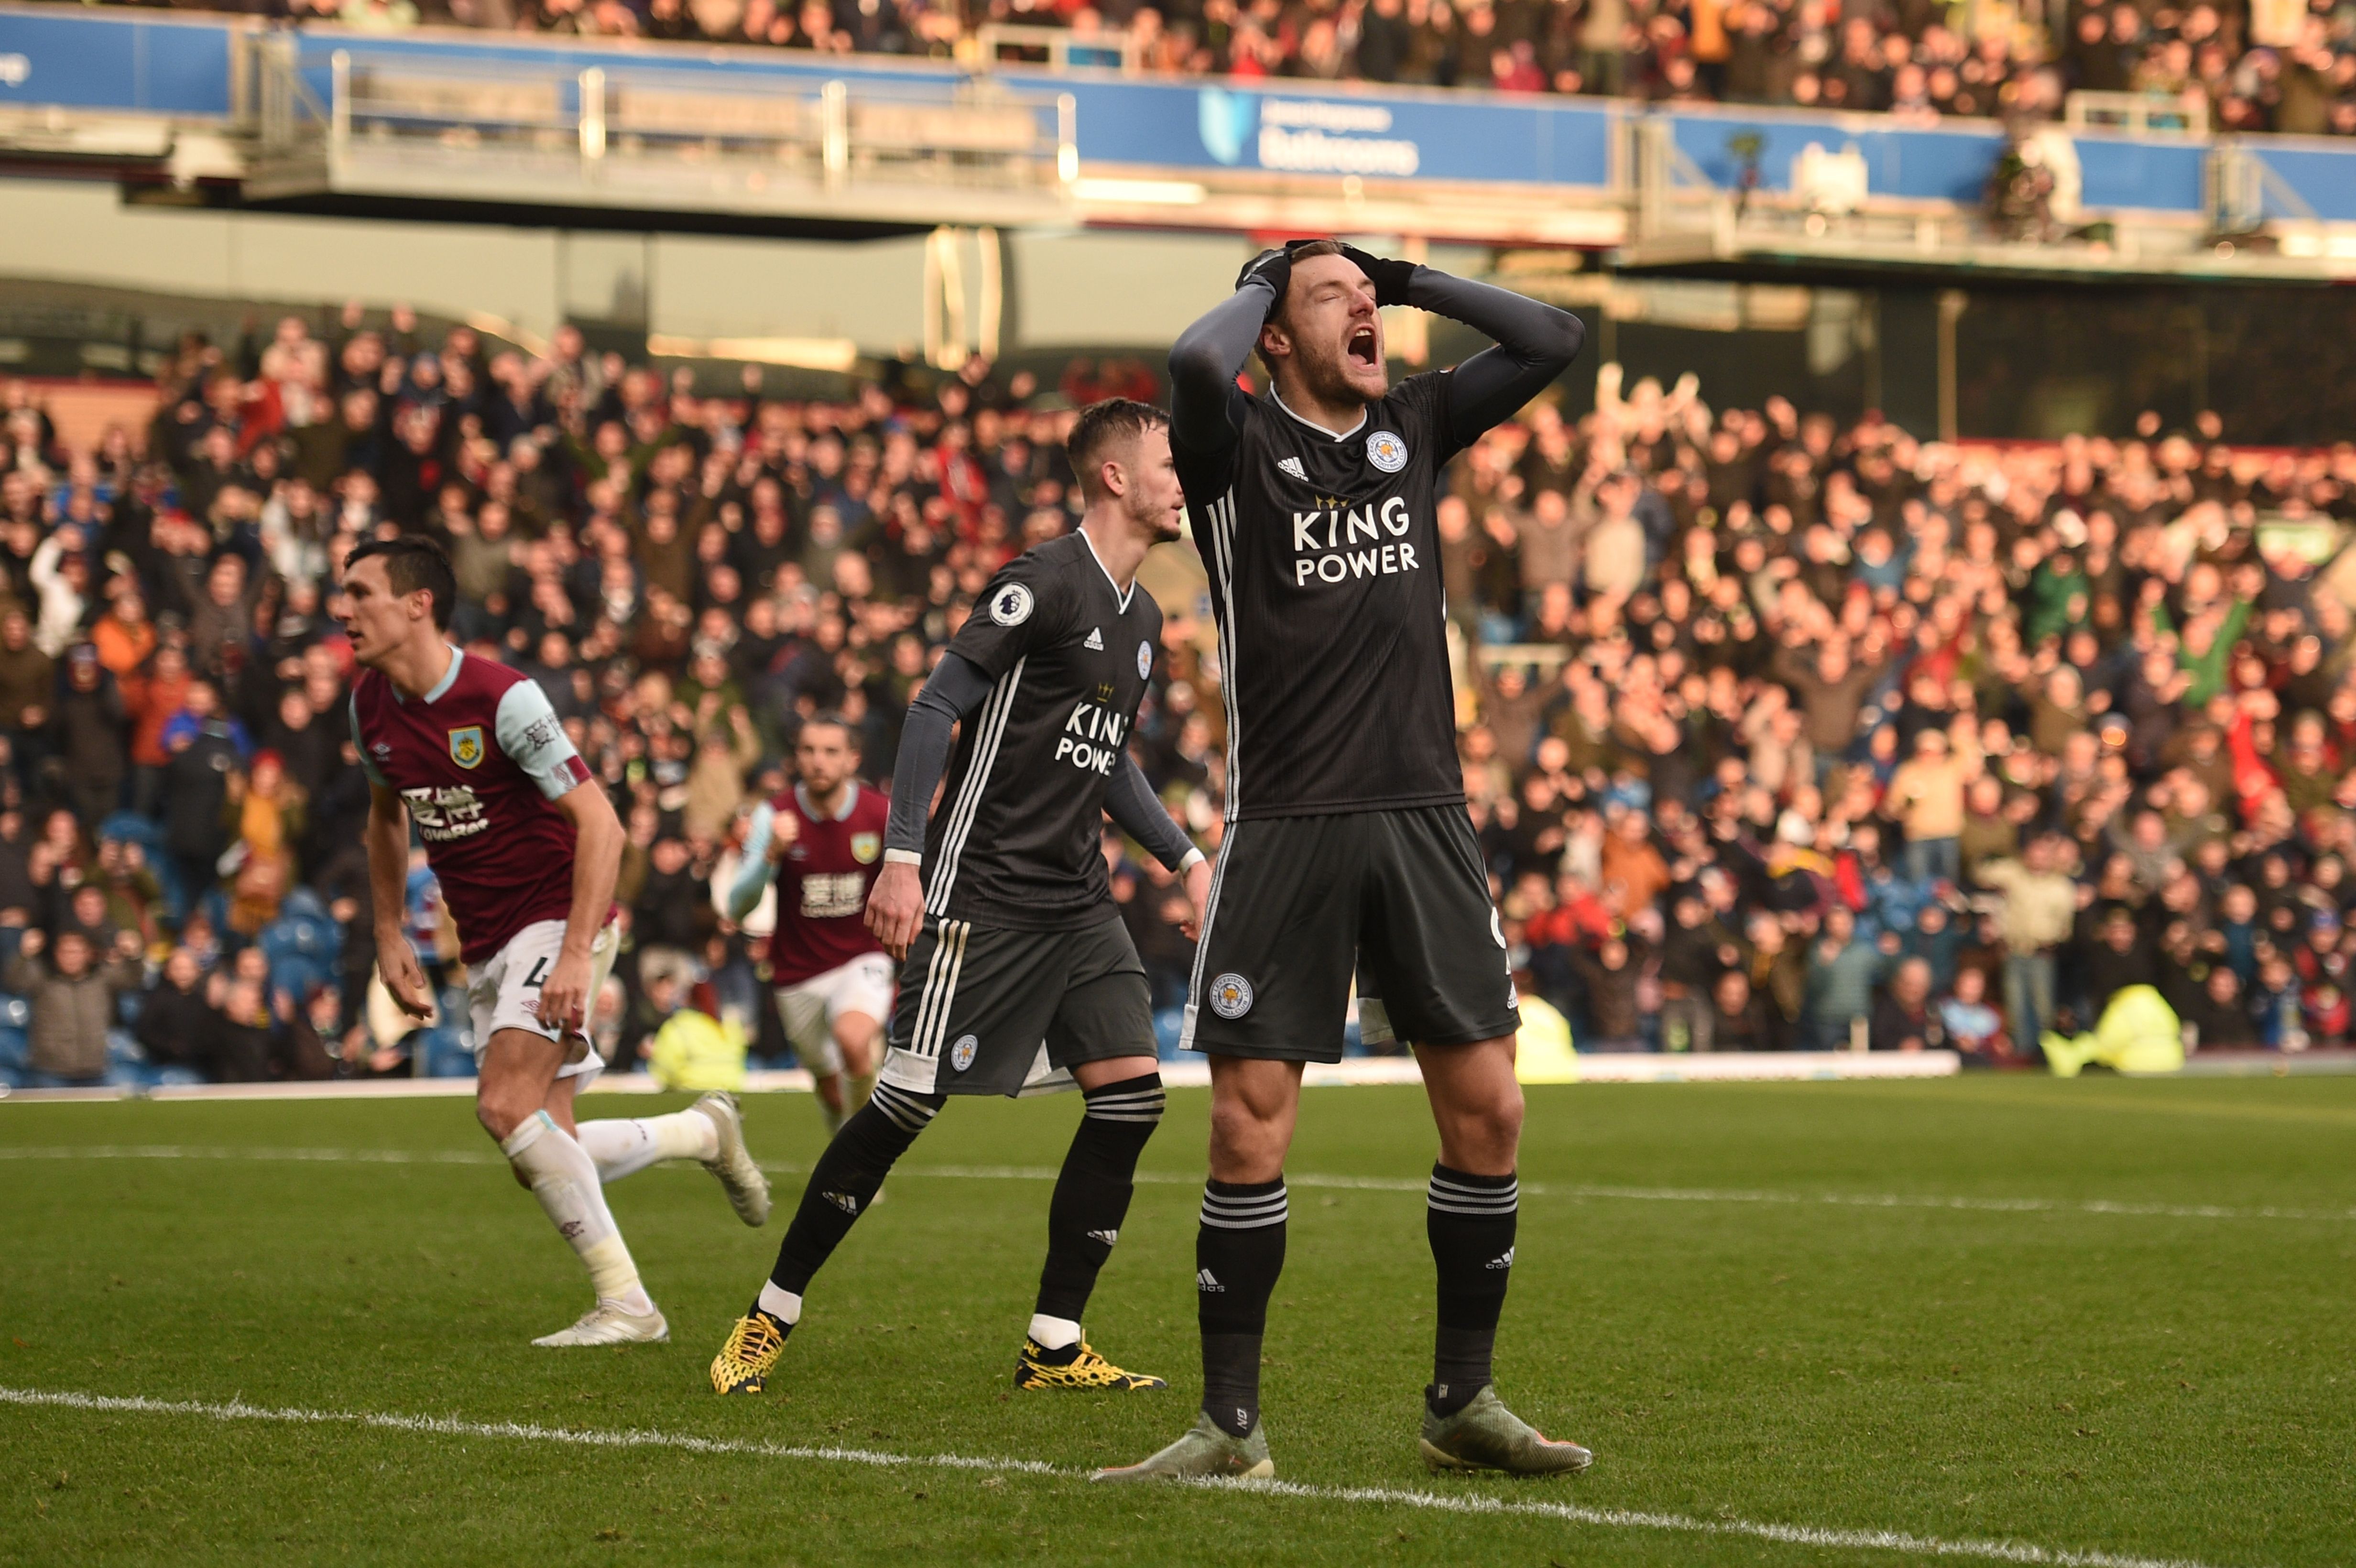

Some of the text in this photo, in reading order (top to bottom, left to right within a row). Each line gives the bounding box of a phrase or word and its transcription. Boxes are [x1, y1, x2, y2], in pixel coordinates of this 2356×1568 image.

[1370, 434, 1398, 457] LEICESTER CITY
[1375, 458, 1402, 468] FOOTBALL
[1293, 496, 1409, 551] KING
[1296, 543, 1419, 586] POWER
[1214, 978, 1242, 992] LEICESTER
[1213, 995, 1248, 1015] FOOTBALL CLUB
[1087, 1231, 1115, 1246] adid
[1485, 1260, 1512, 1269] adid
